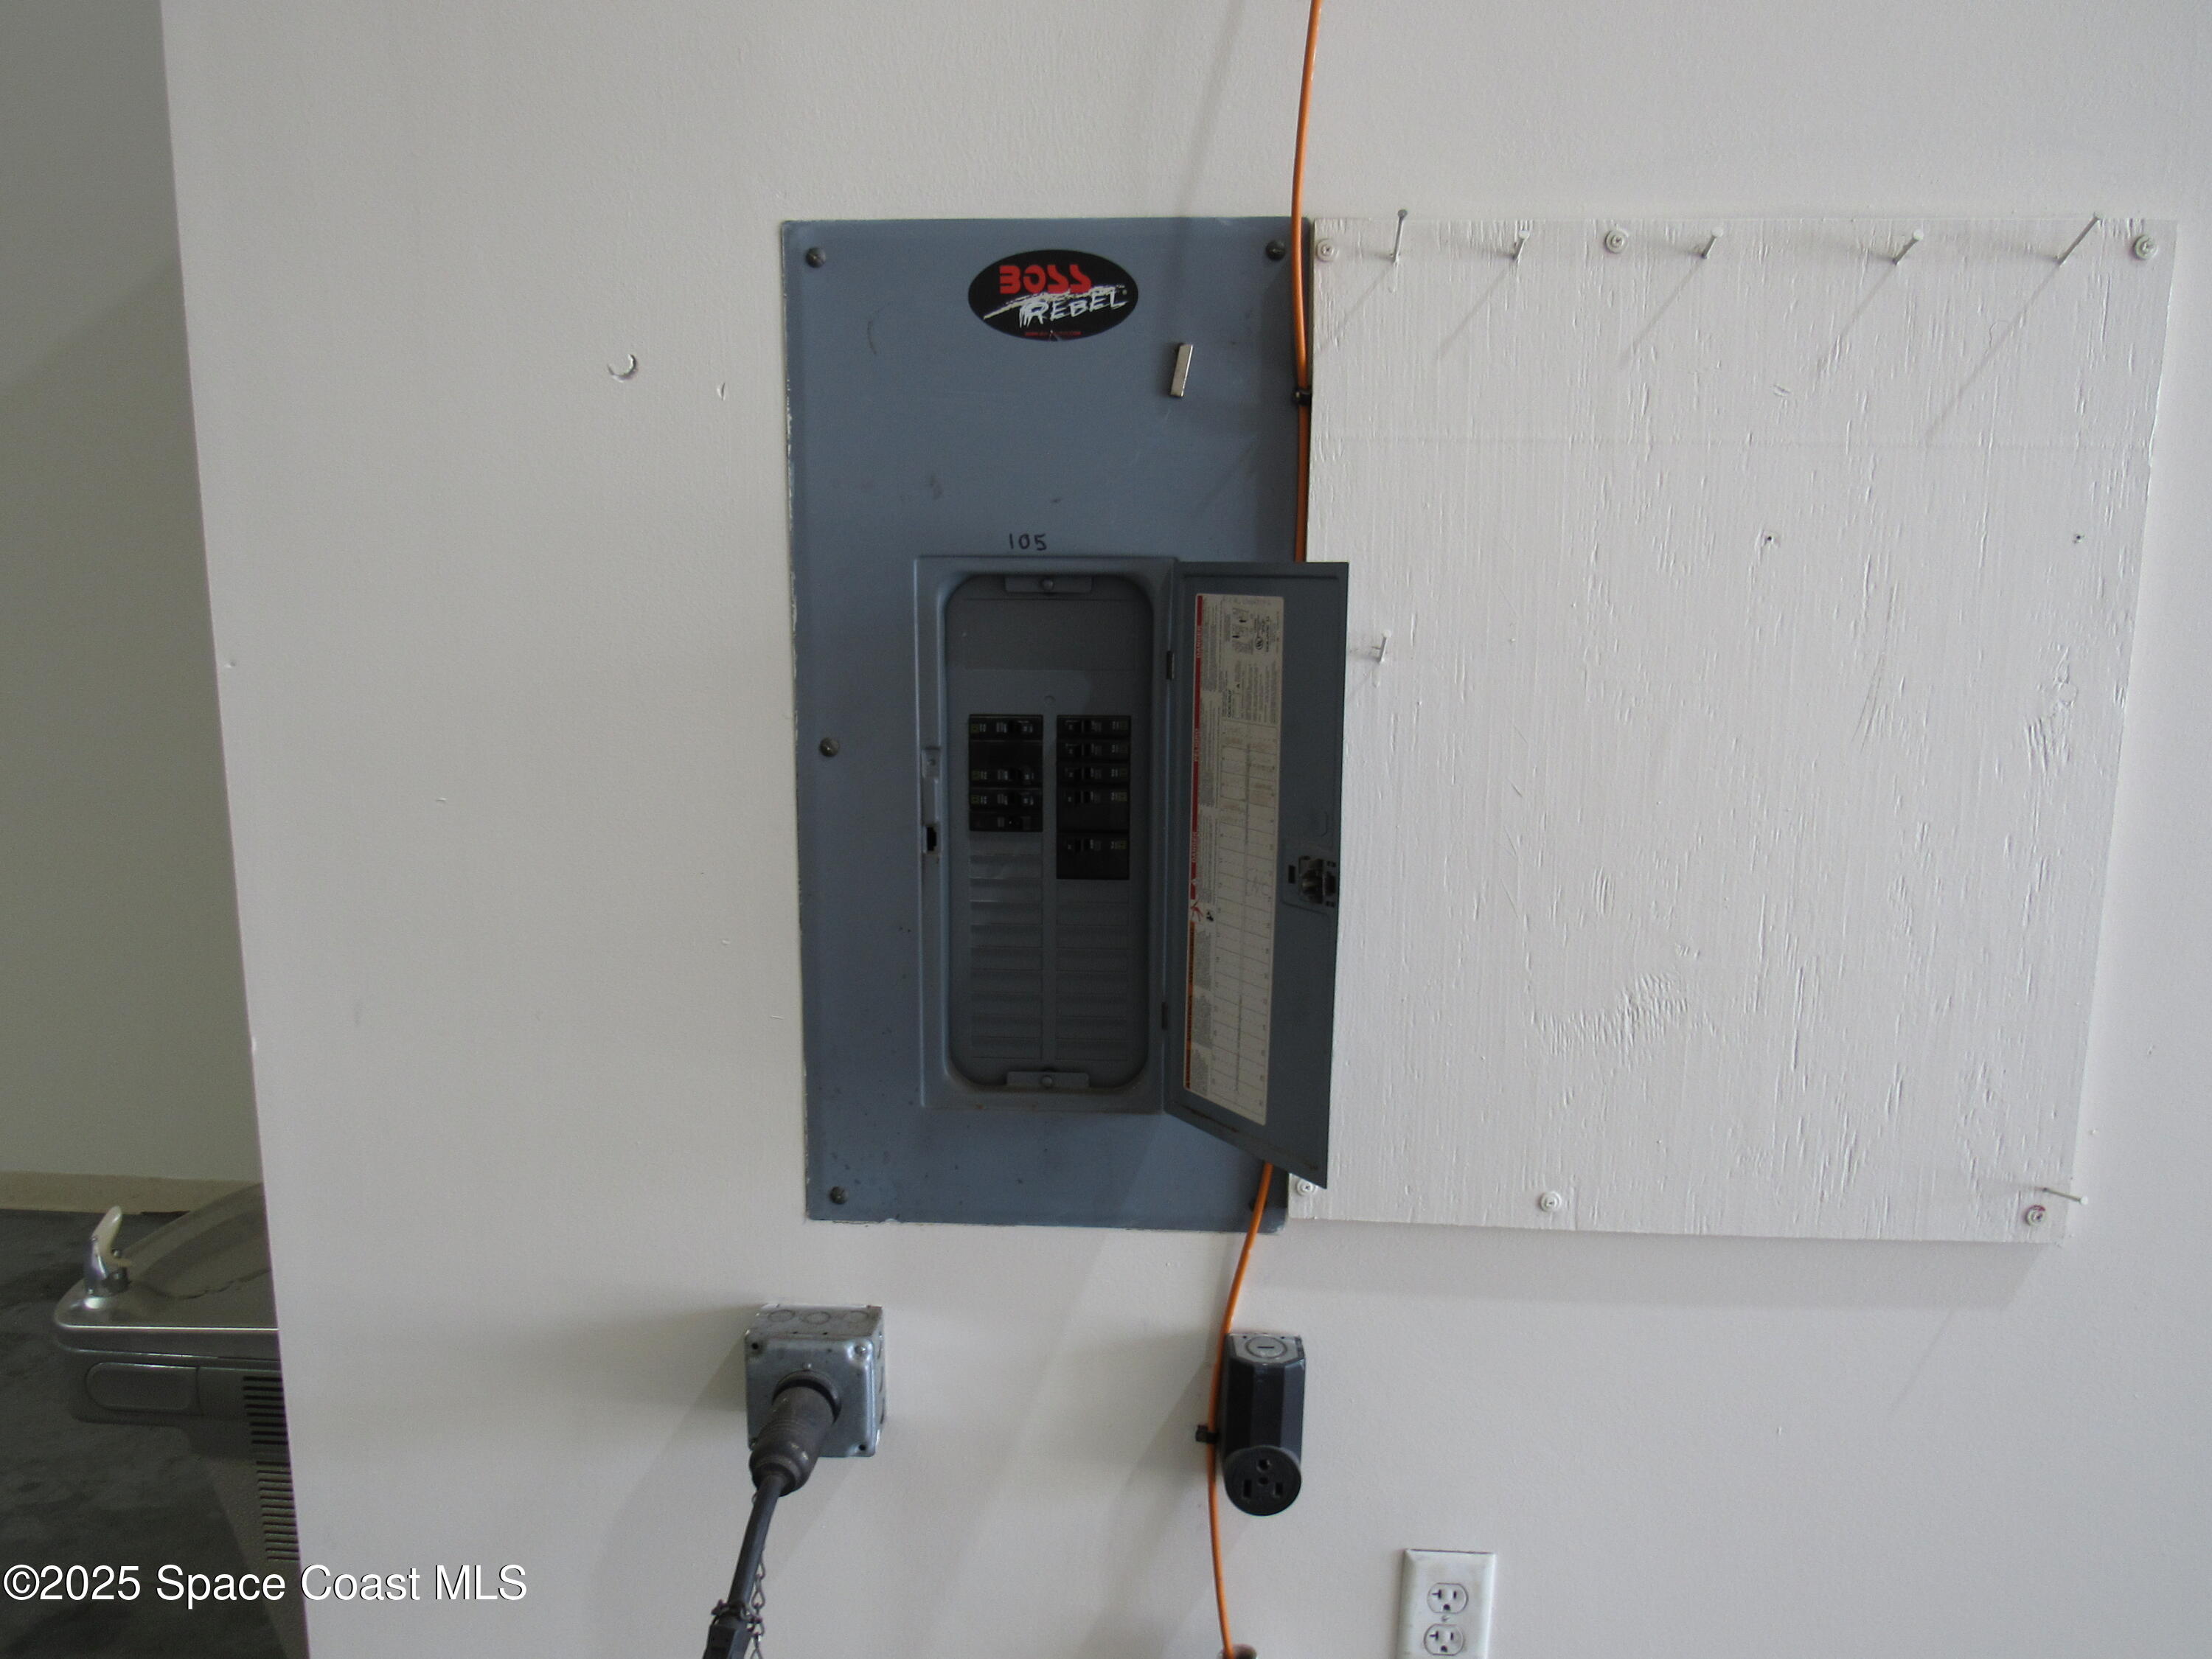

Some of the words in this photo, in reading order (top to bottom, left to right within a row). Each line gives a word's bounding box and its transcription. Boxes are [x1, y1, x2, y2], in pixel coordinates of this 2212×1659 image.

[999, 265, 1092, 294] BOSS
[1018, 286, 1128, 328] REBEL
[1009, 533, 1047, 551] 105
